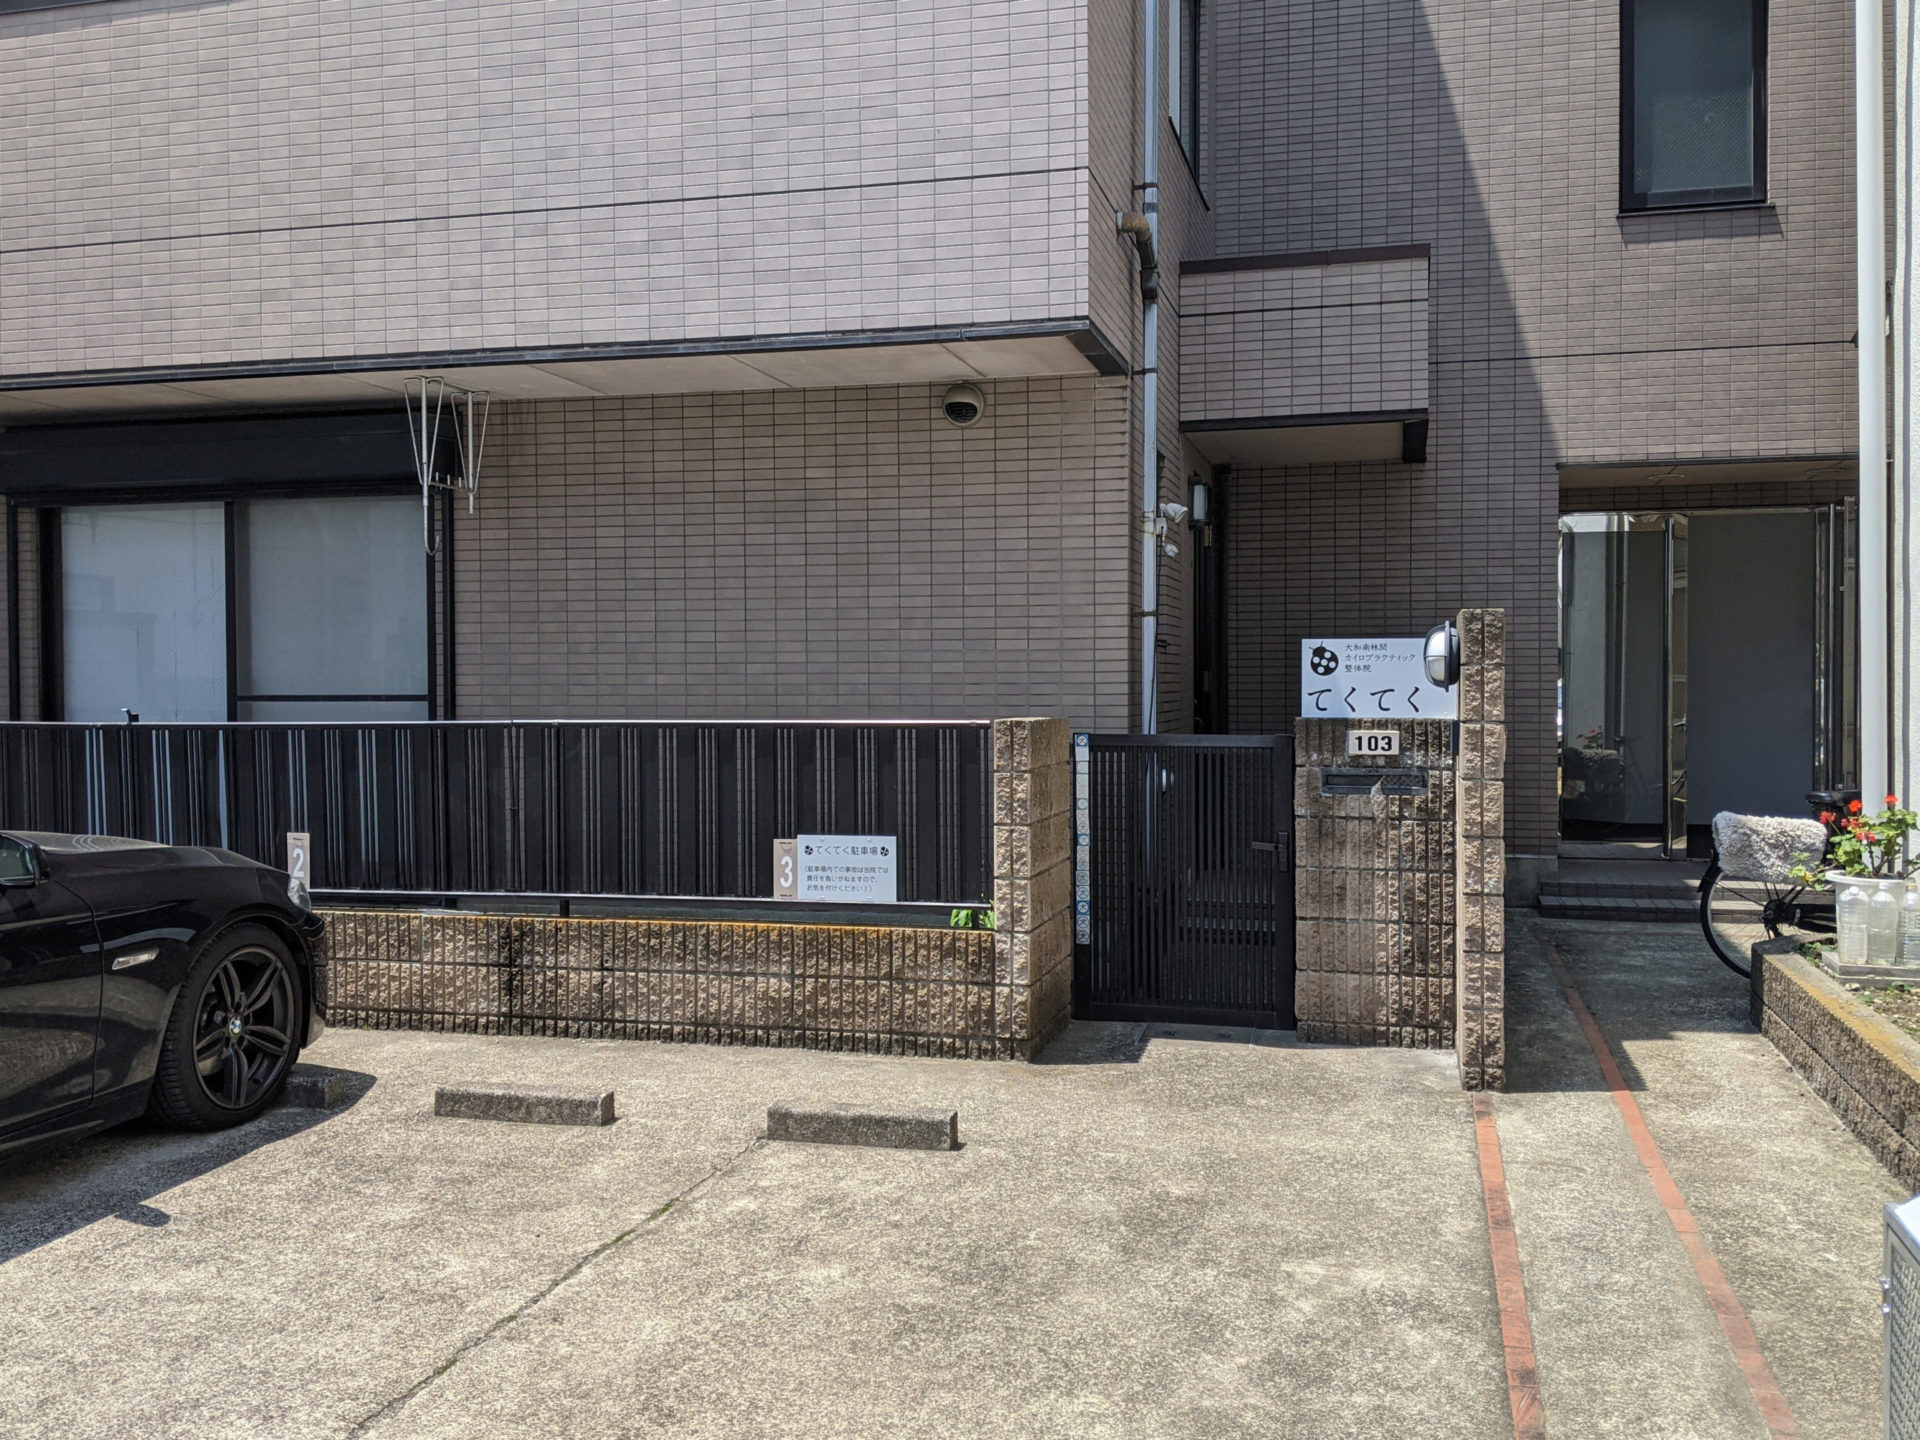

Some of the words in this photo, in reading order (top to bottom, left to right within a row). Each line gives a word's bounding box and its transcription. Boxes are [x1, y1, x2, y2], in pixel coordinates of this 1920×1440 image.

[1345, 643, 1388, 651] 大和南林間
[1345, 654, 1416, 662] カイロプラクティック
[1345, 664, 1372, 673] 整体院
[1307, 686, 1420, 713] てくてく
[1355, 736, 1392, 751] 103
[815, 846, 879, 856] てくてく駐車場
[292, 848, 305, 878] 2
[780, 856, 793, 888] 3
